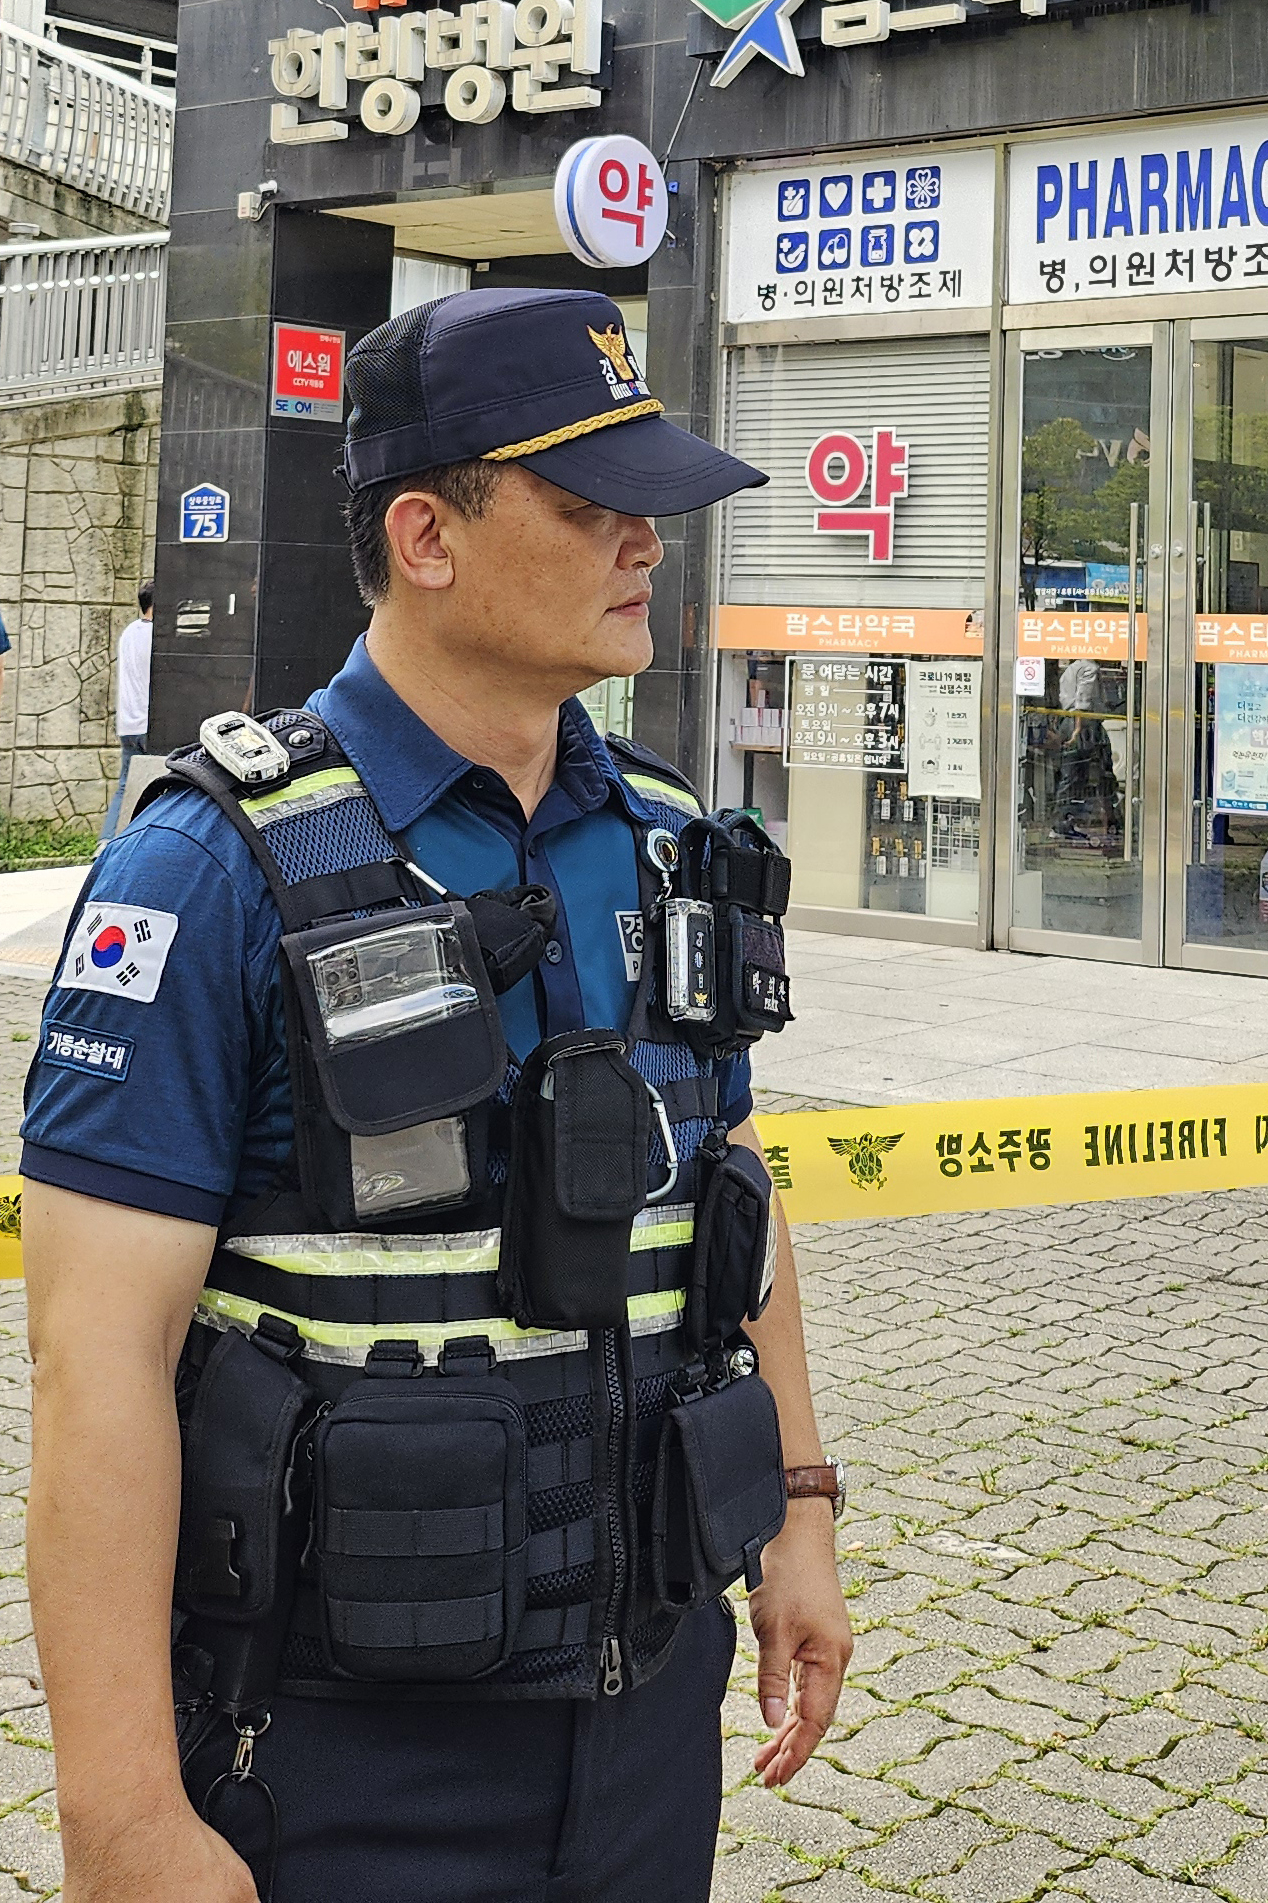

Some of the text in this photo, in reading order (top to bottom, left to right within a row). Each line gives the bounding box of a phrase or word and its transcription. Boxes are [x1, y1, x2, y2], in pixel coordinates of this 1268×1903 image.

[268, 0, 603, 145] 한방병원
[599, 158, 654, 248] 약
[287, 350, 331, 376] 에스원
[806, 428, 908, 563] 약
[191, 514, 218, 537] 75
[786, 613, 915, 638] 팜스타약국
[819, 638, 879, 647] PHARMACY
[1051, 645, 1109, 654] PHARMACY
[864, 665, 893, 682] 시간
[795, 703, 815, 716] 오전
[818, 702, 838, 717] 9시
[854, 702, 876, 719] 오후
[878, 702, 899, 719] 7시
[801, 720, 831, 731] 토요일
[793, 731, 814, 745] 오전
[817, 730, 836, 746] 9시
[853, 733, 876, 748] 오후
[878, 732, 899, 749] 3시
[47, 1031, 126, 1070] 기동순찰대
